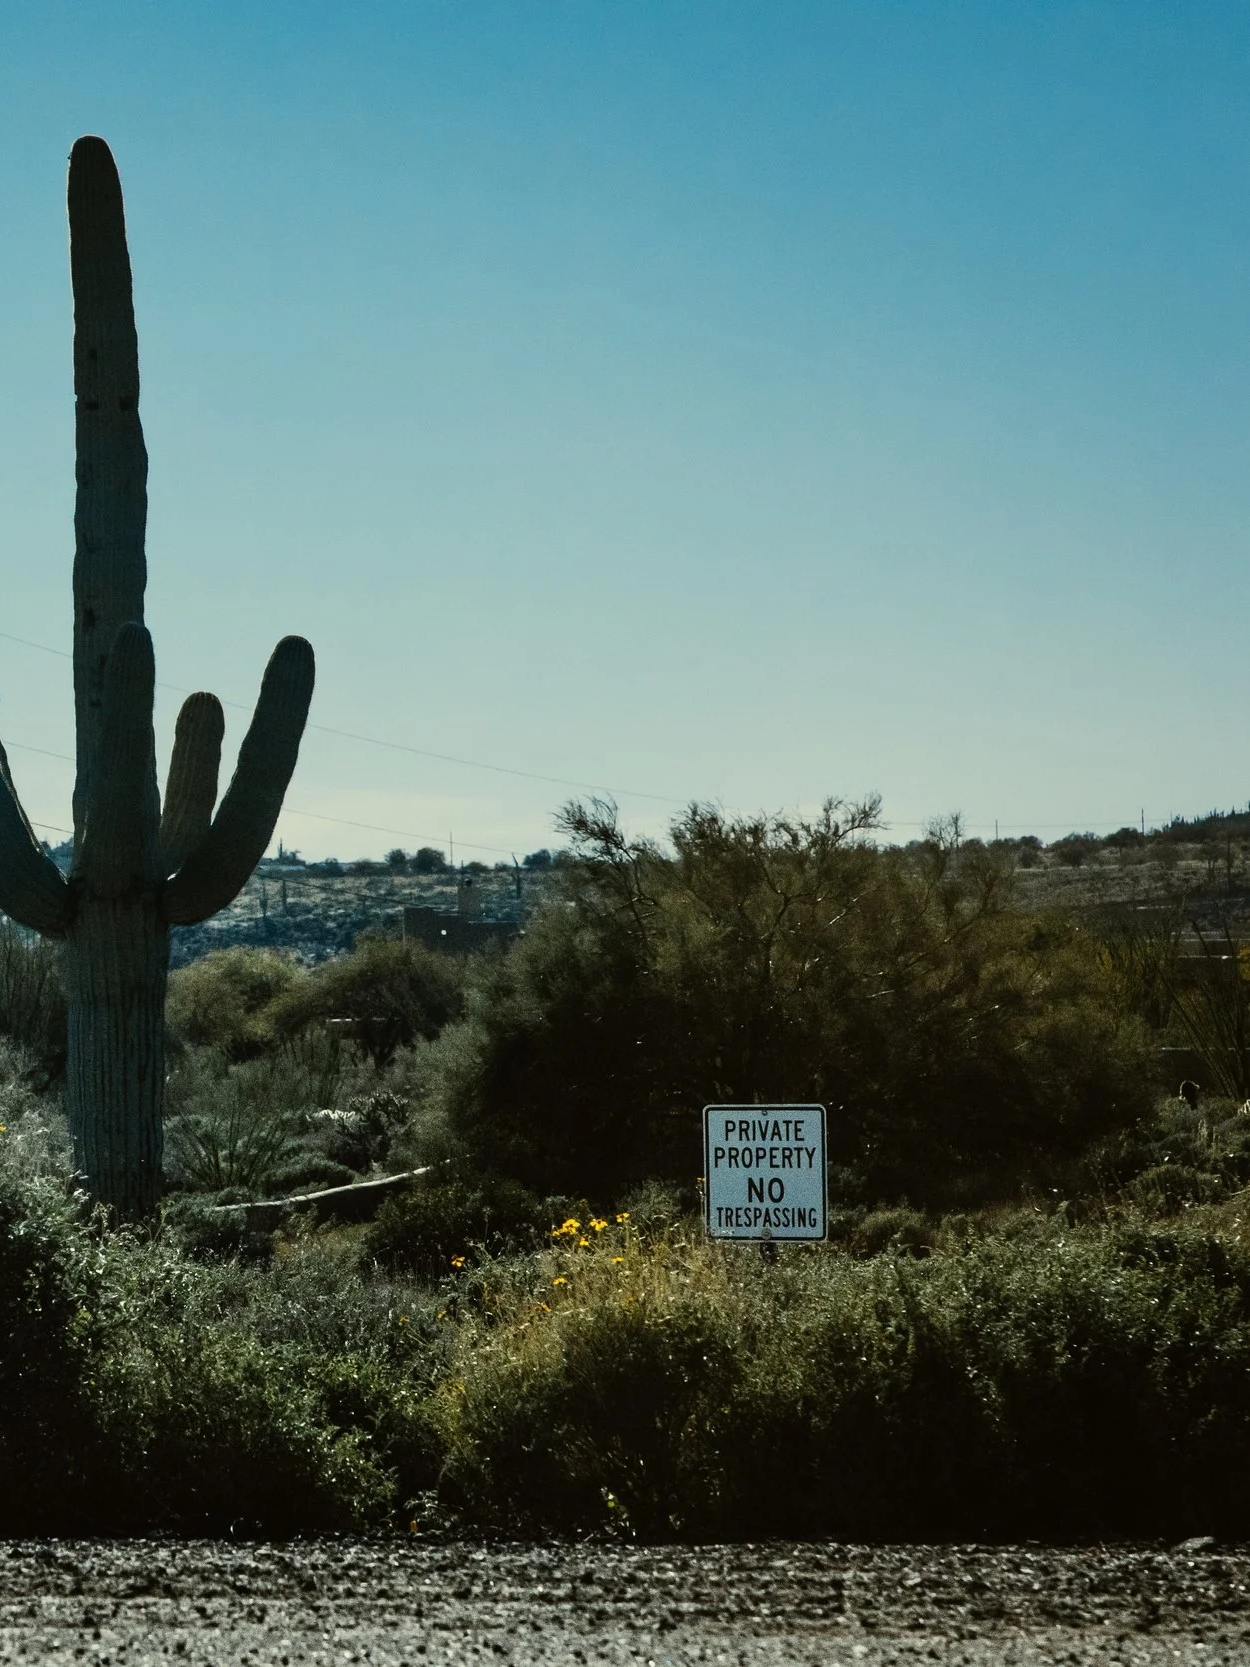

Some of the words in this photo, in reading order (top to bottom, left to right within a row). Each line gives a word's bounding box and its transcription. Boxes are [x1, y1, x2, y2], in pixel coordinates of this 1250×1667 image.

[725, 1120, 805, 1141] PRIVATE
[714, 1147, 816, 1168] PROPERTY
[748, 1177, 784, 1203] NO
[716, 1207, 817, 1228] TRESPASSING
